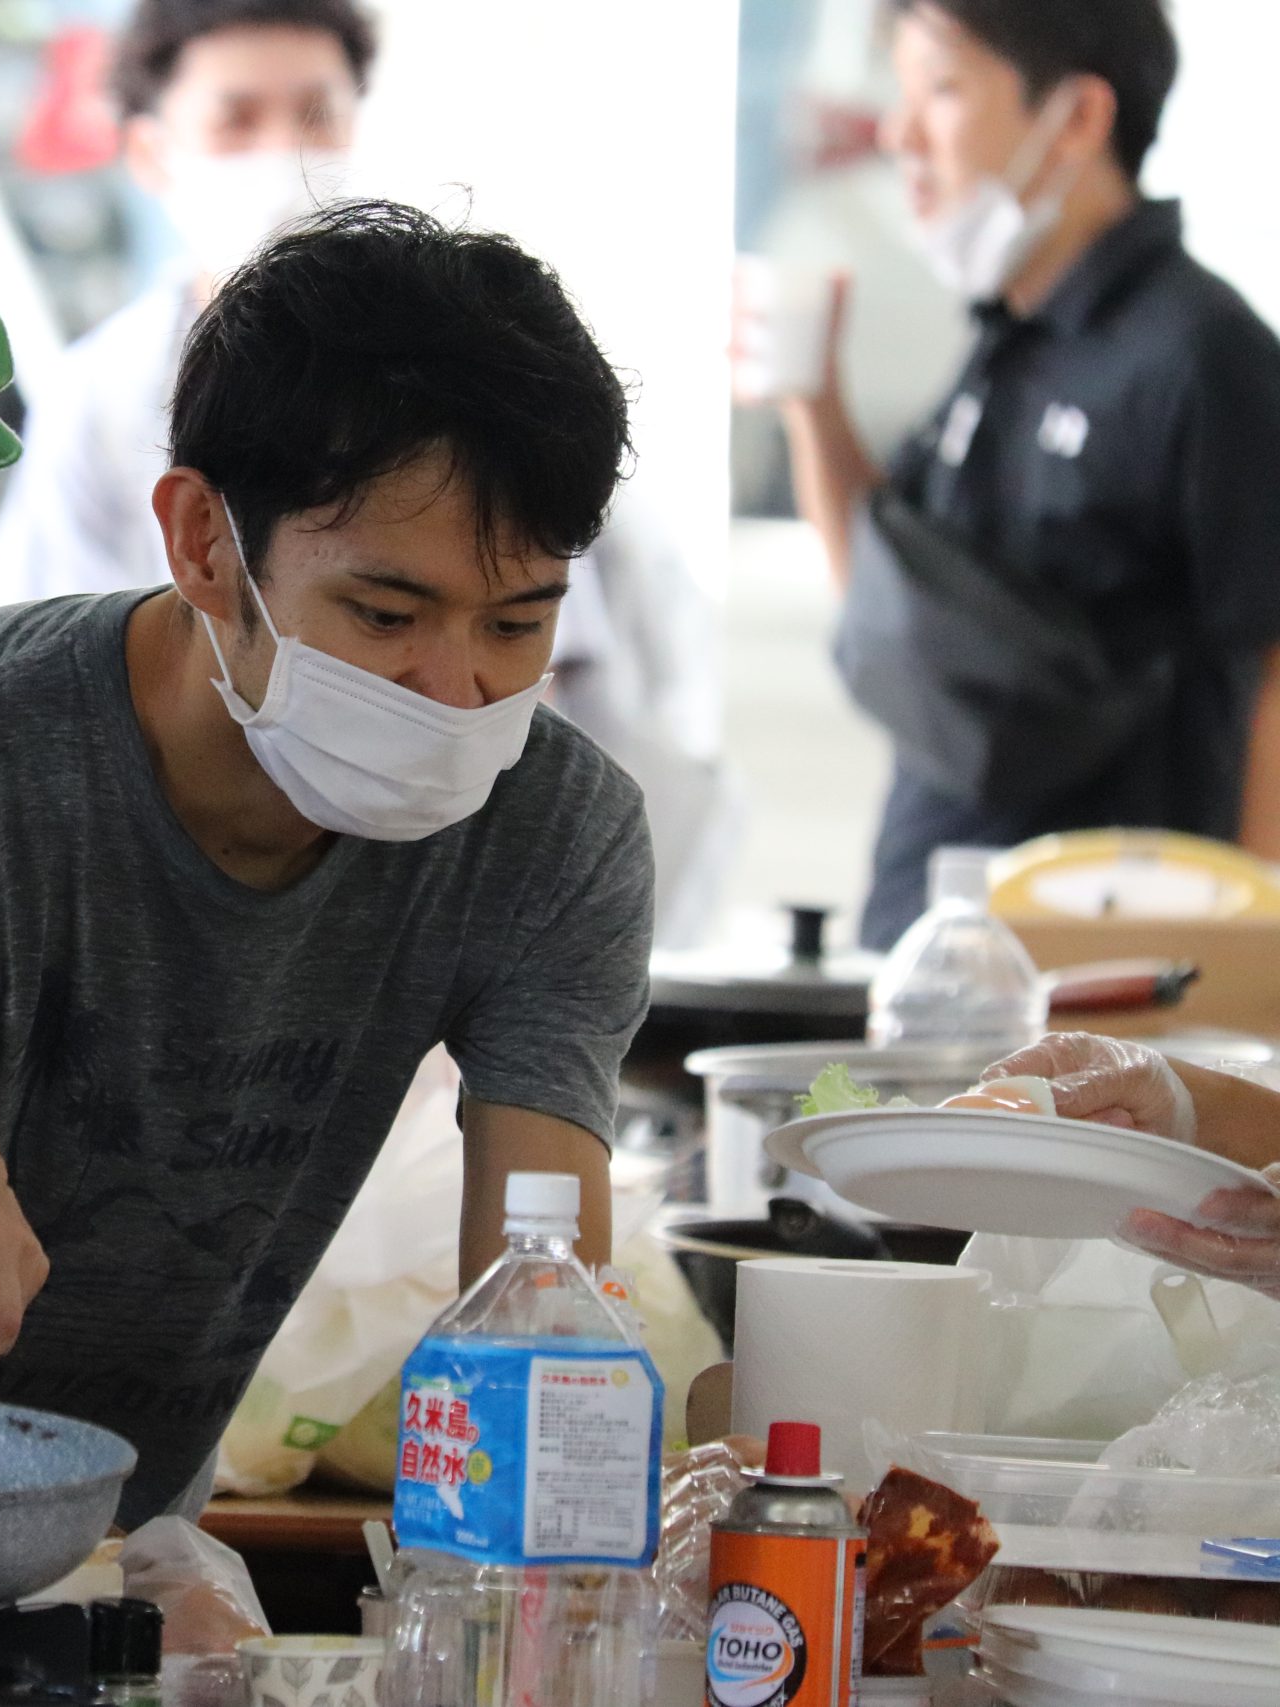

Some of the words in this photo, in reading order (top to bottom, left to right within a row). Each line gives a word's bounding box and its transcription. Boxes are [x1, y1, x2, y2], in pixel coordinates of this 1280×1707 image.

[404, 1391, 480, 1445] 久米島の
[400, 1439, 466, 1487] 自然水
[732, 1585, 788, 1620] BUTANE
[782, 1613, 805, 1649] GAS
[718, 1636, 782, 1661] TOHO
